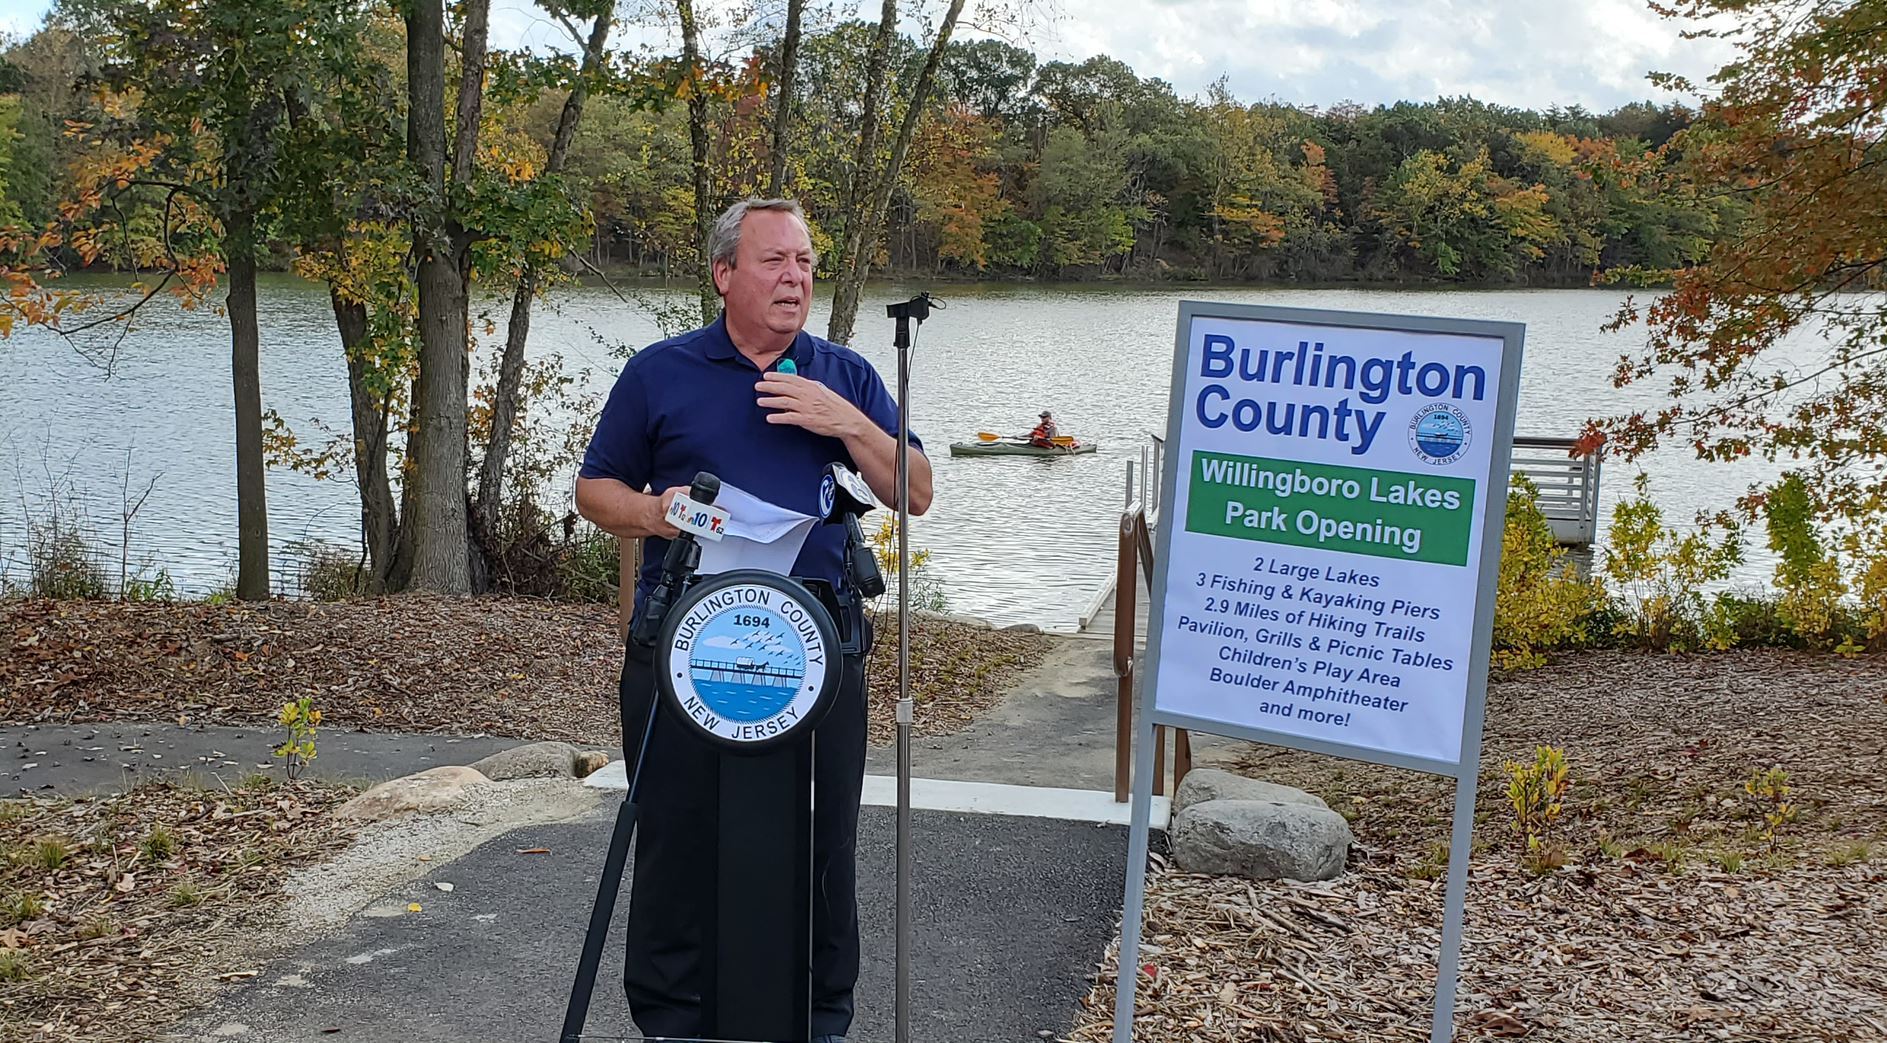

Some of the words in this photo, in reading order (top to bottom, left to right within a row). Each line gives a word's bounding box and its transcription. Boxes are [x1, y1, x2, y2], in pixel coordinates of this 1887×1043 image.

[1200, 334, 1486, 405] Burlington
[1196, 384, 1386, 455] County
[1410, 403, 1448, 430] BURLINGTON
[1452, 408, 1470, 435] COUNTY
[1413, 447, 1428, 461] NEW
[1432, 452, 1461, 465] JERSEY
[1201, 458, 1361, 498] Willingboro
[1369, 477, 1461, 510] Lakes
[693, 512, 708, 528] 10
[1225, 501, 1288, 532] Park
[1296, 510, 1421, 554] Opening
[1253, 557, 1264, 572] 2
[1268, 559, 1320, 582] Large
[1325, 566, 1380, 588] Lakes
[1196, 572, 1206, 587] 3
[1210, 574, 1276, 600] Fishing
[1281, 584, 1294, 600] &
[1299, 587, 1386, 616] Kayaking
[1391, 599, 1441, 620] Piers
[675, 588, 771, 652] BURLINGTON
[780, 601, 823, 666] COUNTY
[733, 614, 770, 628] 1694
[1204, 597, 1230, 614] 2.9
[1233, 601, 1280, 622] Miles
[1285, 610, 1306, 625] of
[1307, 611, 1367, 638] Hiking
[1374, 621, 1426, 643] Trails
[1178, 616, 1248, 643] Pavilion,
[1255, 628, 1303, 649] Grills
[1308, 636, 1321, 651] &
[1326, 639, 1385, 661] Picnic
[1392, 648, 1454, 671] Tables
[1209, 667, 1280, 692] Boulder
[1282, 680, 1409, 713] Amphitheater
[1313, 660, 1354, 683] Play
[1357, 668, 1401, 688] Area
[684, 696, 721, 731] NEW
[731, 707, 799, 740] JERSEY
[1259, 701, 1294, 718] and
[1297, 708, 1351, 727] more!
